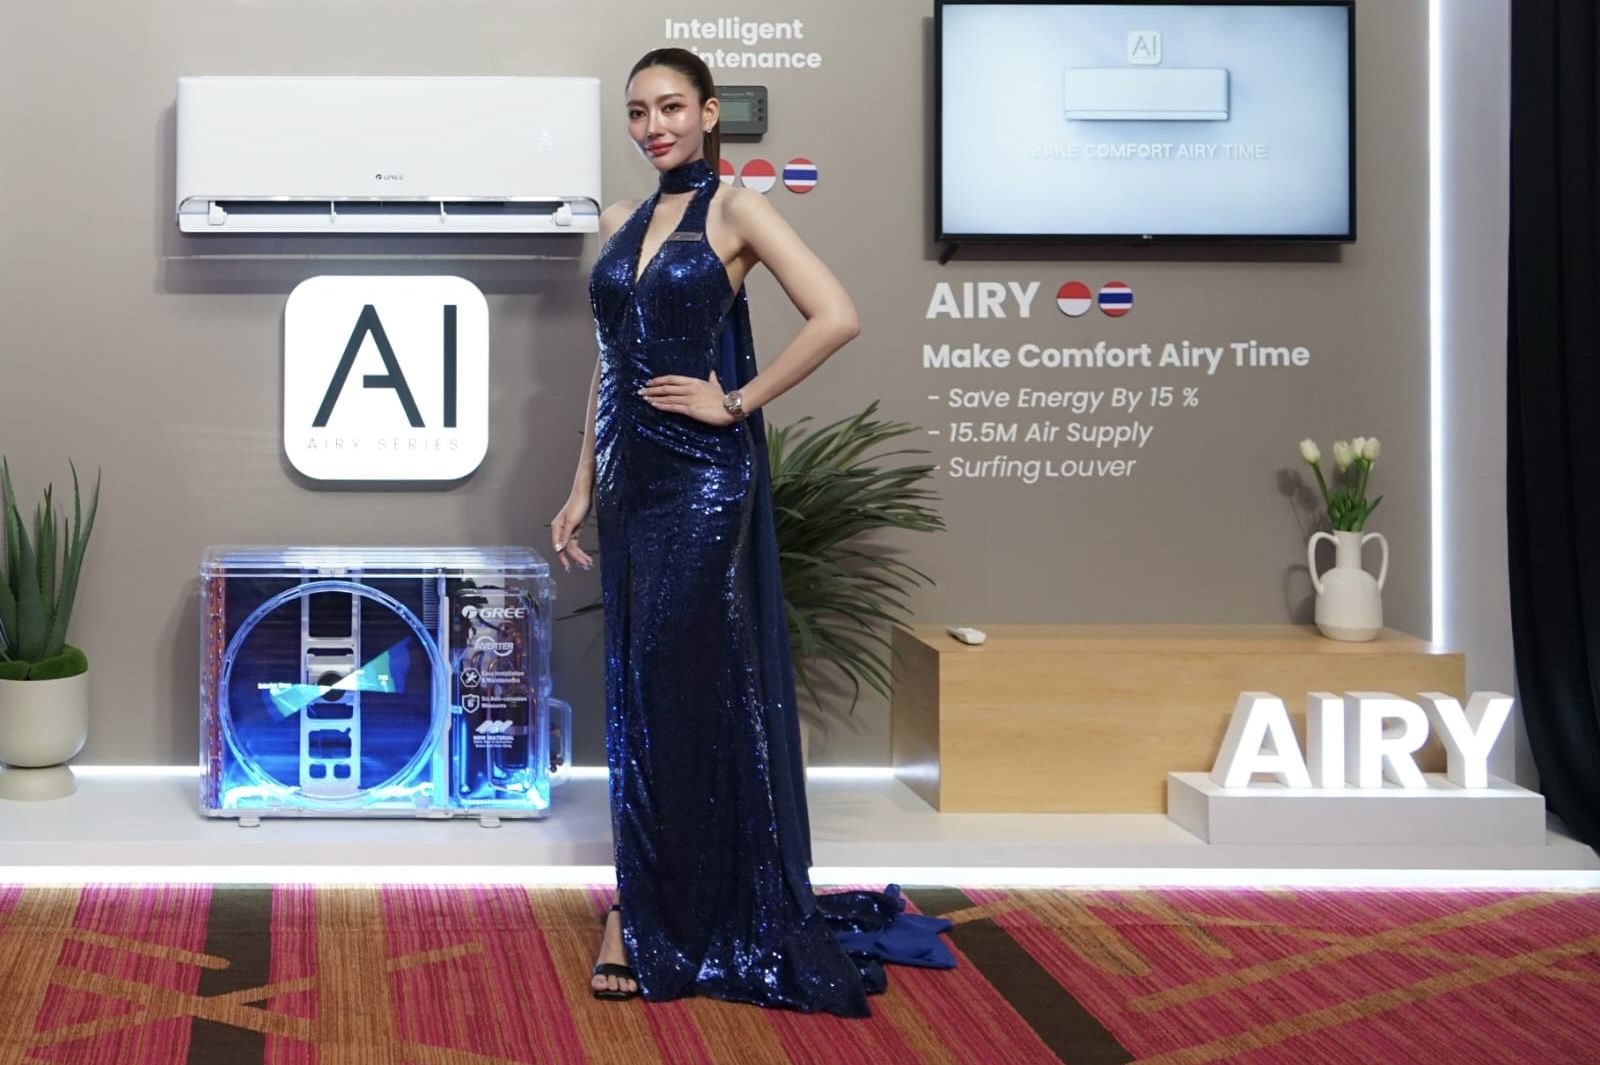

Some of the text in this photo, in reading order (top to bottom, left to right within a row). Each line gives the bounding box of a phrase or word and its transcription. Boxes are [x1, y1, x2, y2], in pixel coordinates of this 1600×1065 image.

[664, 16, 803, 46] Intelligent
[691, 46, 823, 69] ntenance
[1132, 35, 1156, 57] AI
[1087, 142, 1174, 159] COMFORT
[1177, 142, 1217, 159] AIRY
[1224, 143, 1269, 159] TIME
[925, 281, 1041, 319] AIRY
[311, 304, 458, 428] AI
[922, 340, 1311, 375] Make Comfort Airy Time
[948, 387, 1011, 408] Save
[1017, 387, 1105, 414] Energy
[1111, 387, 1143, 413] By
[1150, 386, 1174, 407] 15
[307, 437, 459, 451] AIRY SERIES
[949, 421, 1018, 443] 15.5M
[1024, 421, 1060, 442] Air
[1066, 421, 1154, 449] Supply
[949, 455, 1137, 484] Surfing Louver
[479, 607, 527, 619] GREE
[474, 642, 514, 651] INVERTER
[1212, 692, 1515, 789] AIRY
